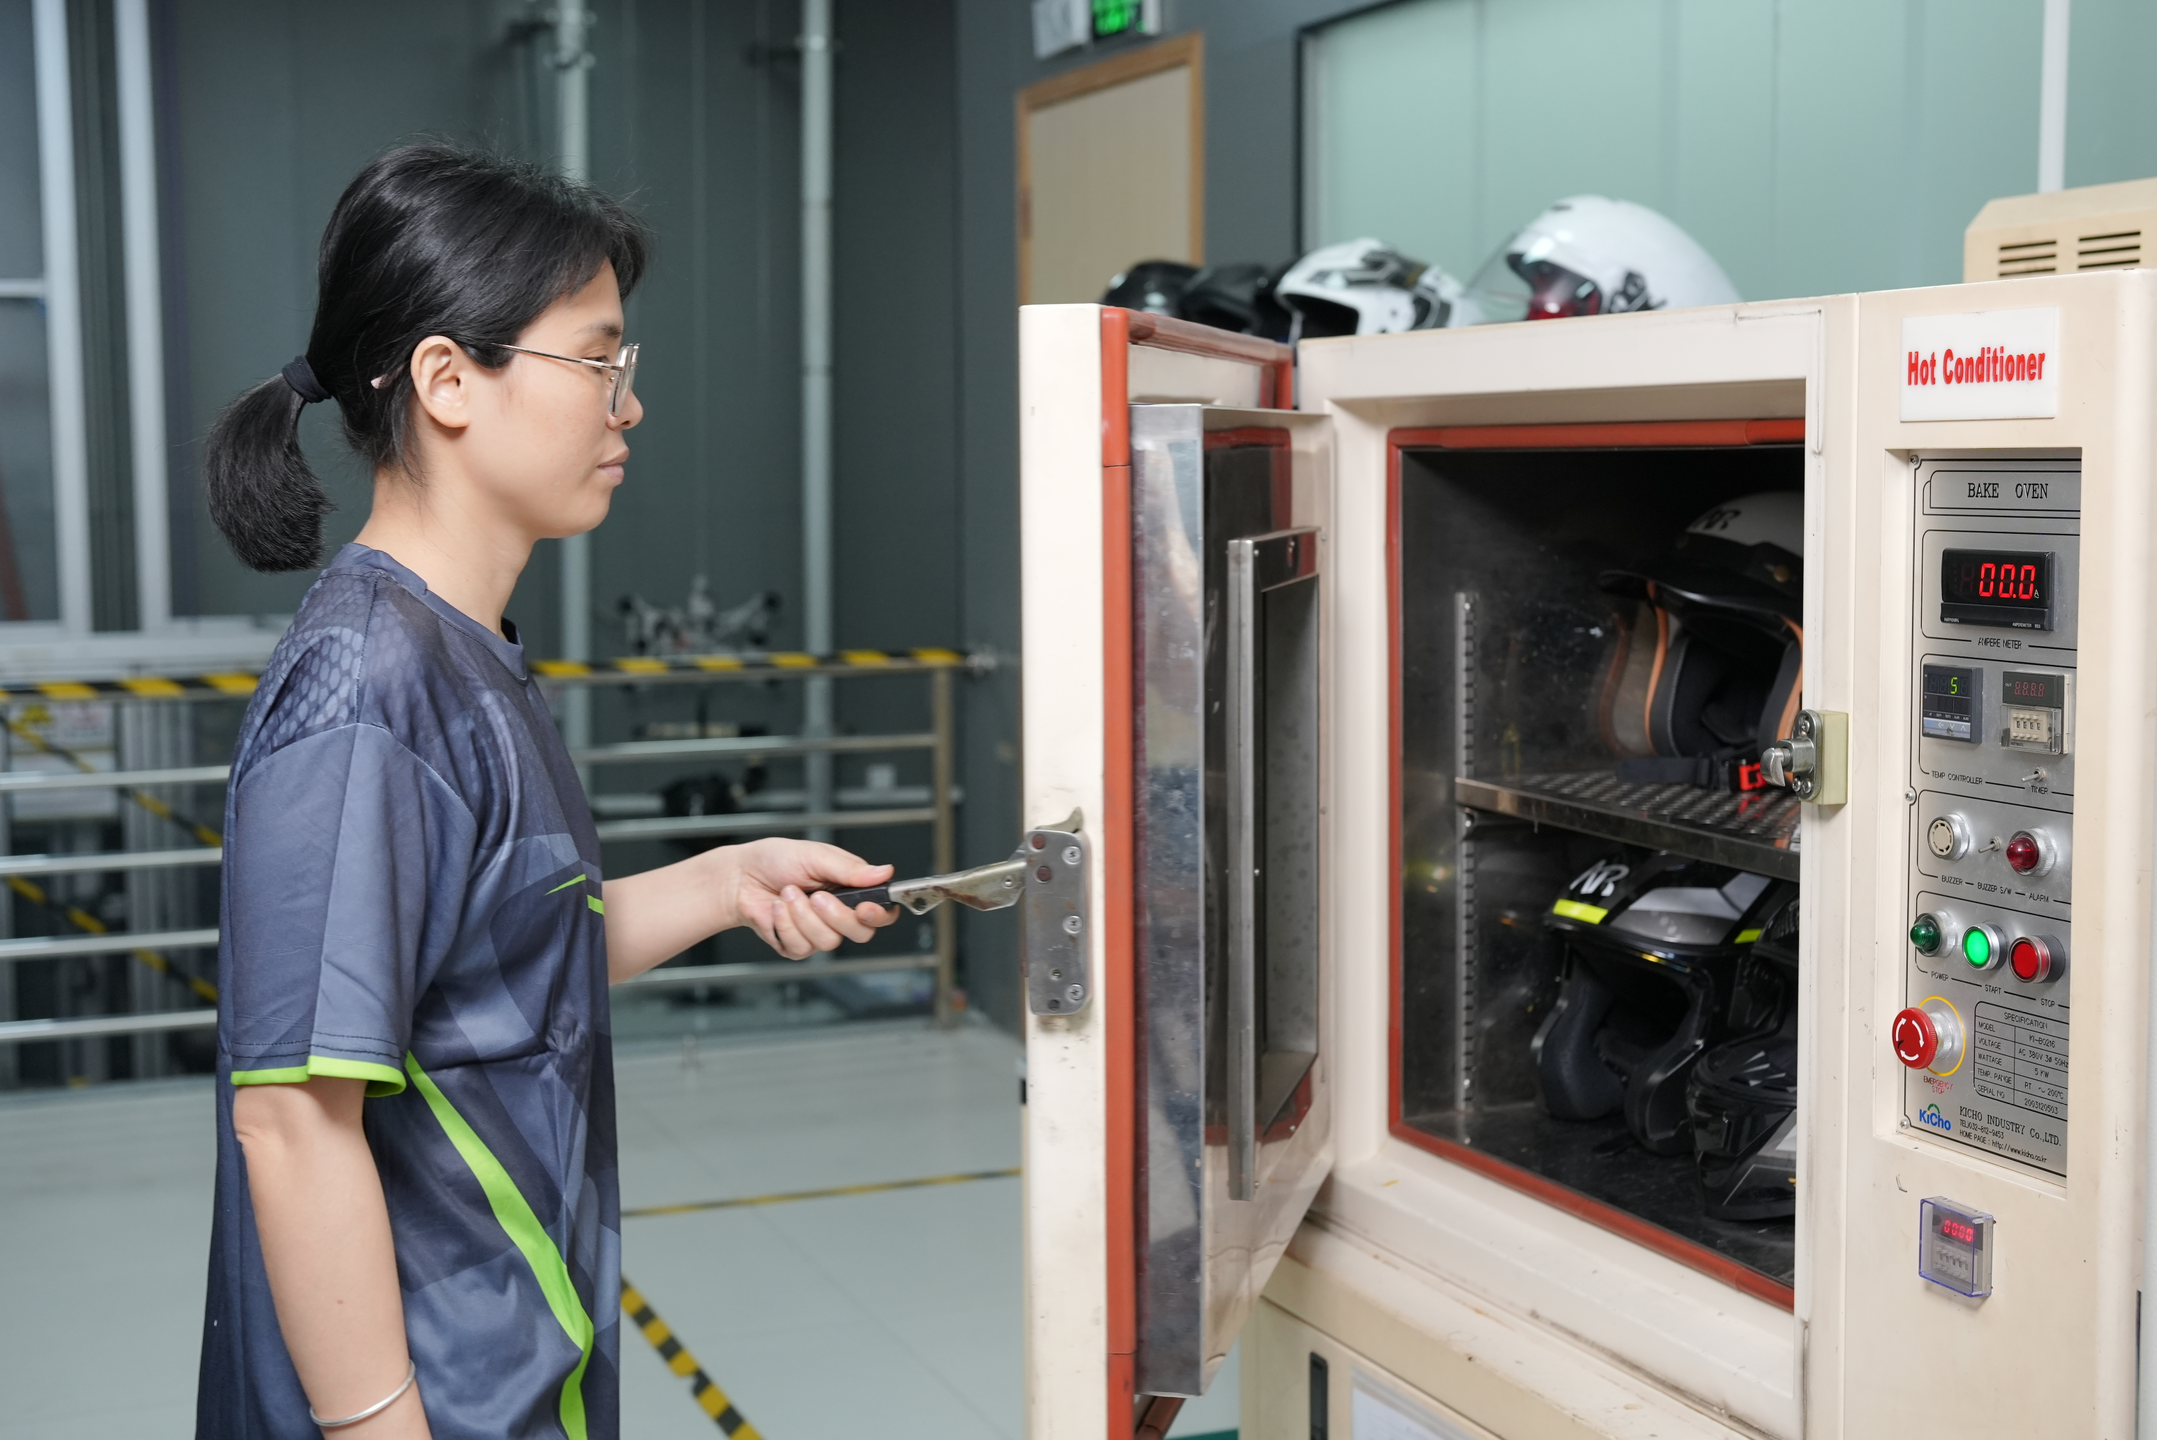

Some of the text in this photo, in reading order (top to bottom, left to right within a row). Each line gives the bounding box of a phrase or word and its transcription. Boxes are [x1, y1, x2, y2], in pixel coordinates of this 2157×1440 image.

[1908, 346, 2045, 385] Hot Conditioner
[1967, 482, 2048, 499] BAKE OVEN
[1979, 563, 2036, 600] 00.0
[1978, 637, 2022, 649] AMPERE METER
[1950, 676, 1959, 694] 5
[1932, 771, 1983, 785] TEMP CONTROLLER
[2031, 785, 2049, 795] TIMER
[1941, 875, 1963, 886] BUZZER
[1978, 882, 1997, 893] BUZZER
[2029, 892, 2049, 903] ALARM
[1931, 970, 1949, 981] POWER
[1984, 984, 2002, 995] START
[2041, 998, 2055, 1008] STOP
[1978, 1021, 1996, 1033] MODEL
[2004, 1012, 2048, 1030] SPECIFICATION
[1978, 1036, 2002, 1050] VOLTAGE
[1978, 1052, 2002, 1066] WATTAGE
[1923, 1075, 1954, 1090] EMERGENCY
[1993, 1073, 2012, 1085] RANGE
[1931, 1085, 1945, 1095] STOP
[1978, 1084, 1996, 1097] SERIAL
[1919, 1108, 1952, 1131] KiCho
[1960, 1105, 1983, 1121] KICHO
[1987, 1114, 2025, 1135] INDUSTRY
[1960, 1129, 1973, 1140] HOME
[1973, 1133, 1987, 1145] PAGE
